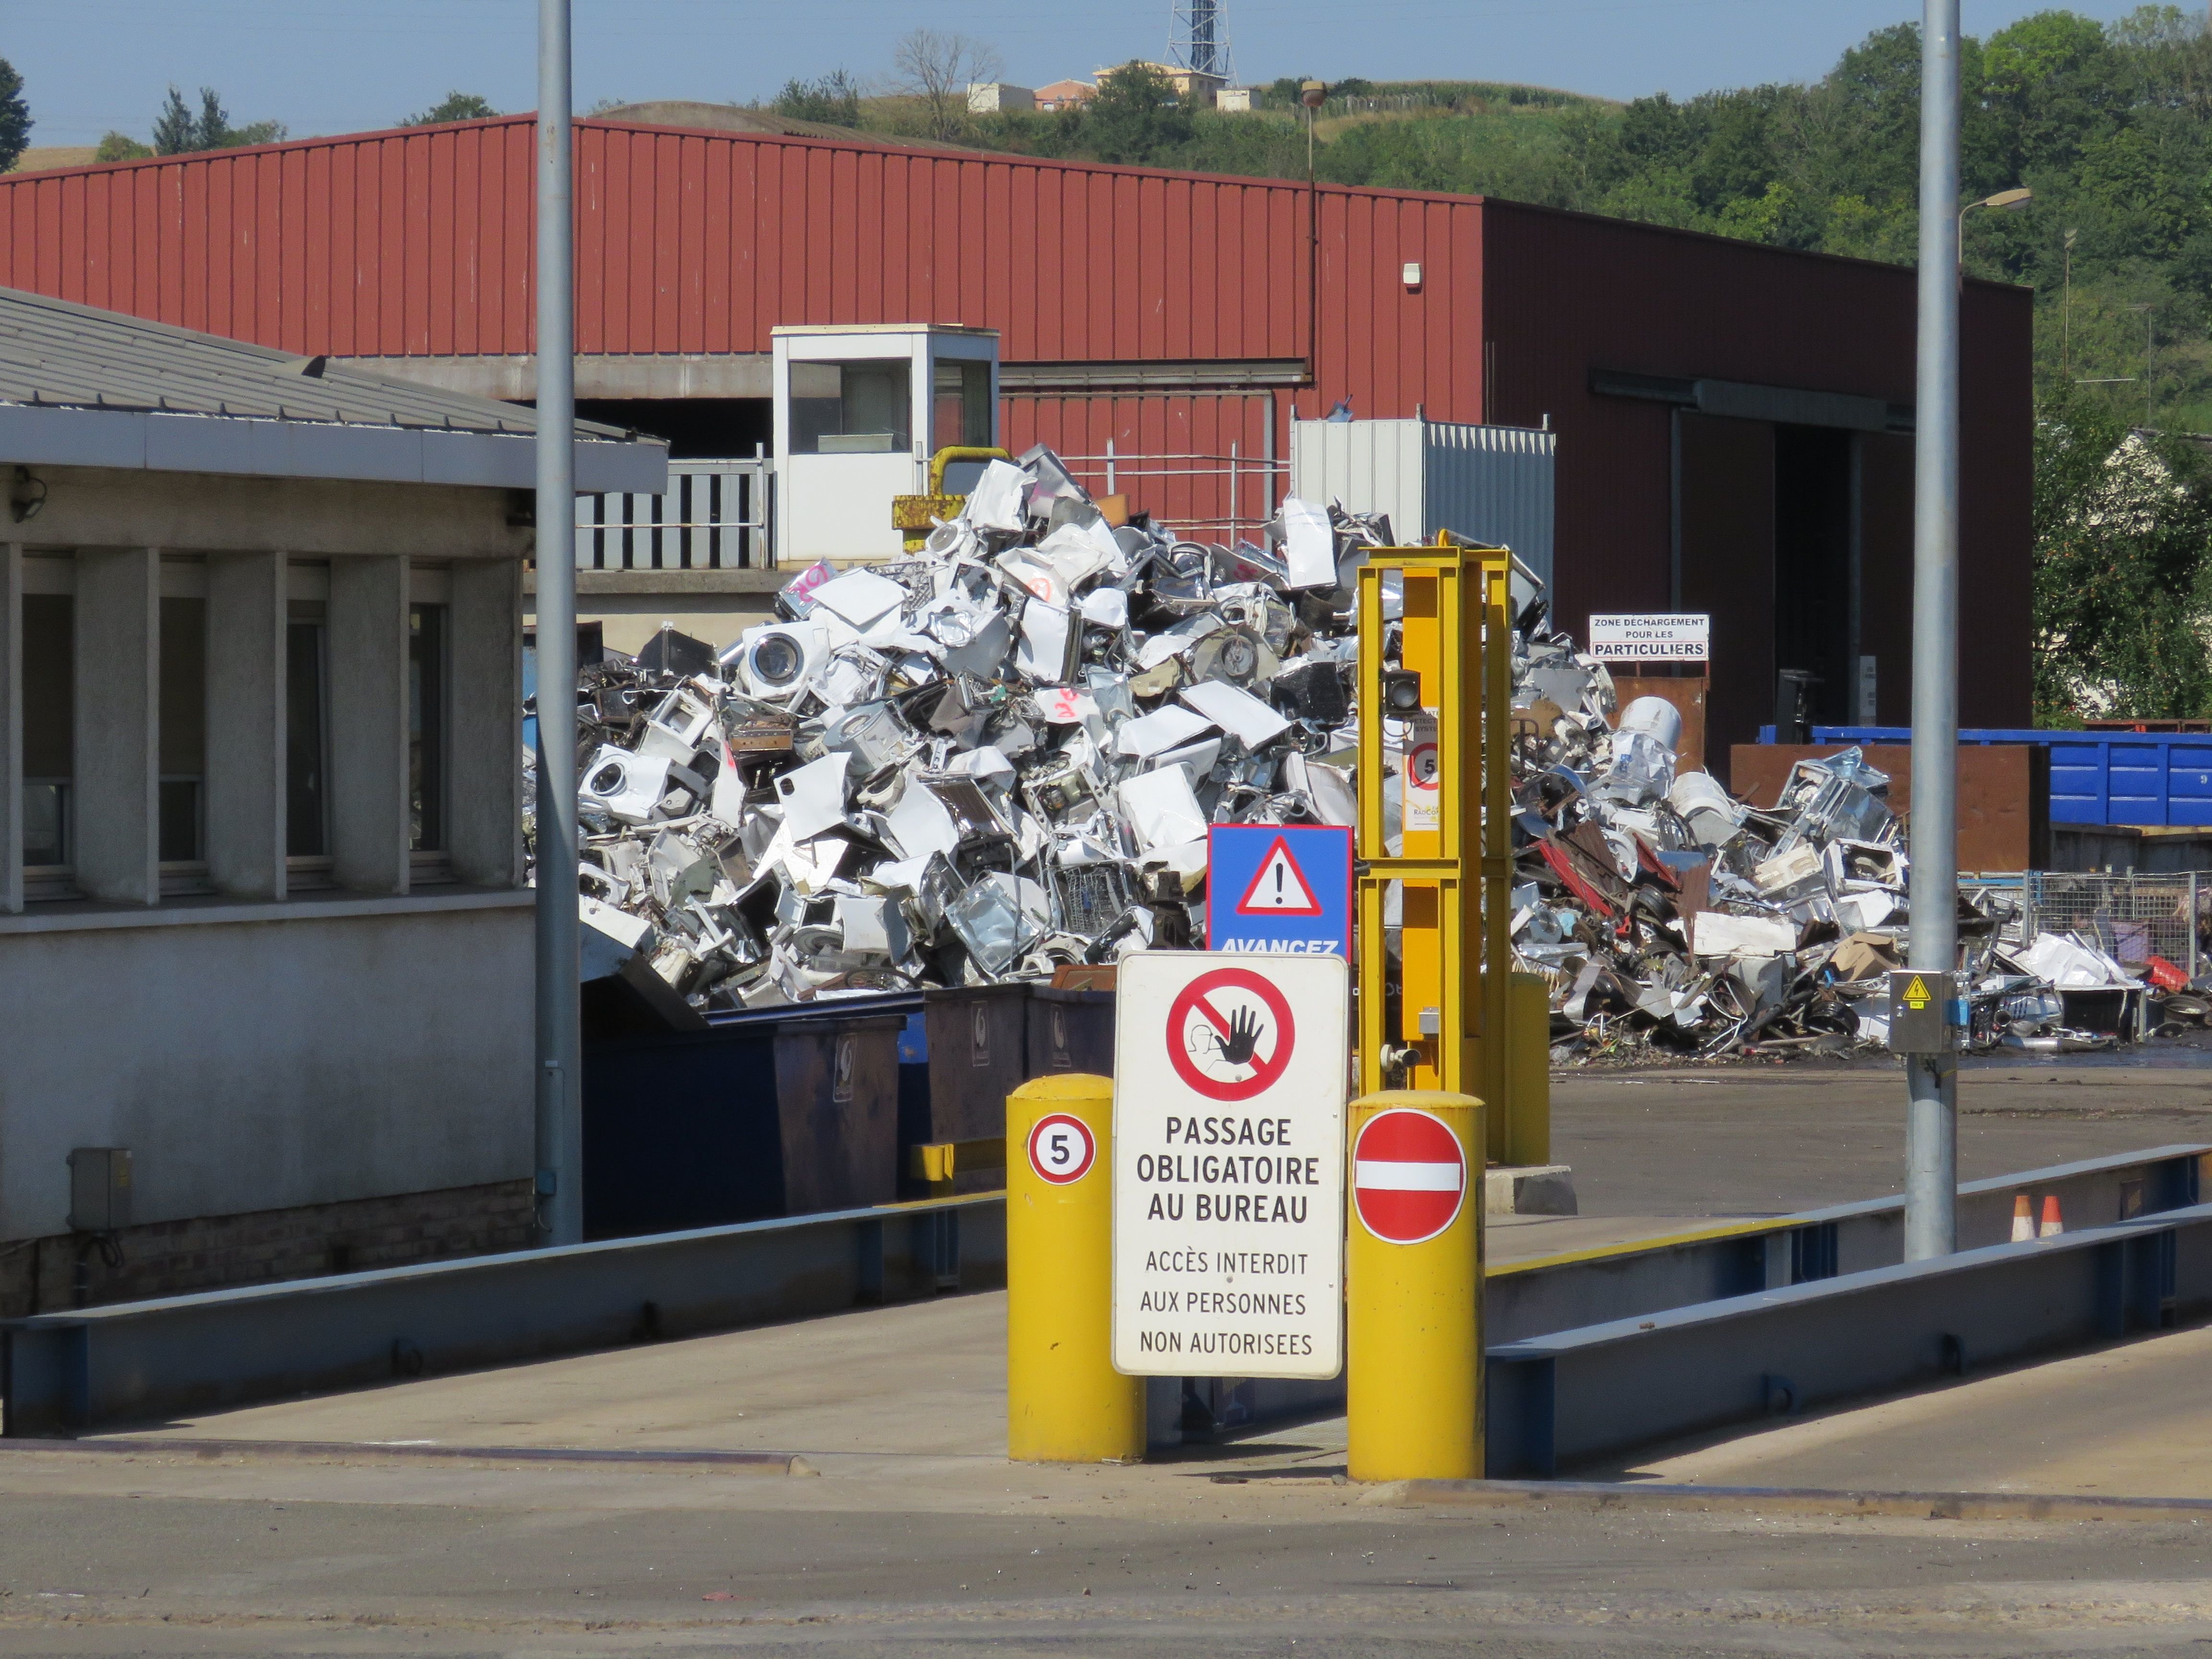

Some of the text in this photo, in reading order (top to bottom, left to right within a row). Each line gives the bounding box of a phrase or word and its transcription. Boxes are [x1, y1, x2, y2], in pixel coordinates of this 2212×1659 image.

[1595, 644, 1704, 655] PARTICULIERS
[1424, 759, 1435, 774] 5
[1222, 938, 1339, 953] AVANCEZ
[1166, 1117, 1291, 1146] PASSAGE
[1051, 1135, 1070, 1165] 5
[1137, 1154, 1320, 1185] OBLIGATOIRE
[1147, 1193, 1307, 1223] AU BUREAU
[1145, 1245, 1308, 1274] ACCÈS INTERDIT
[1140, 1291, 1306, 1315] AUX PERSONNES
[1140, 1331, 1312, 1356] NON AUTORISEES
